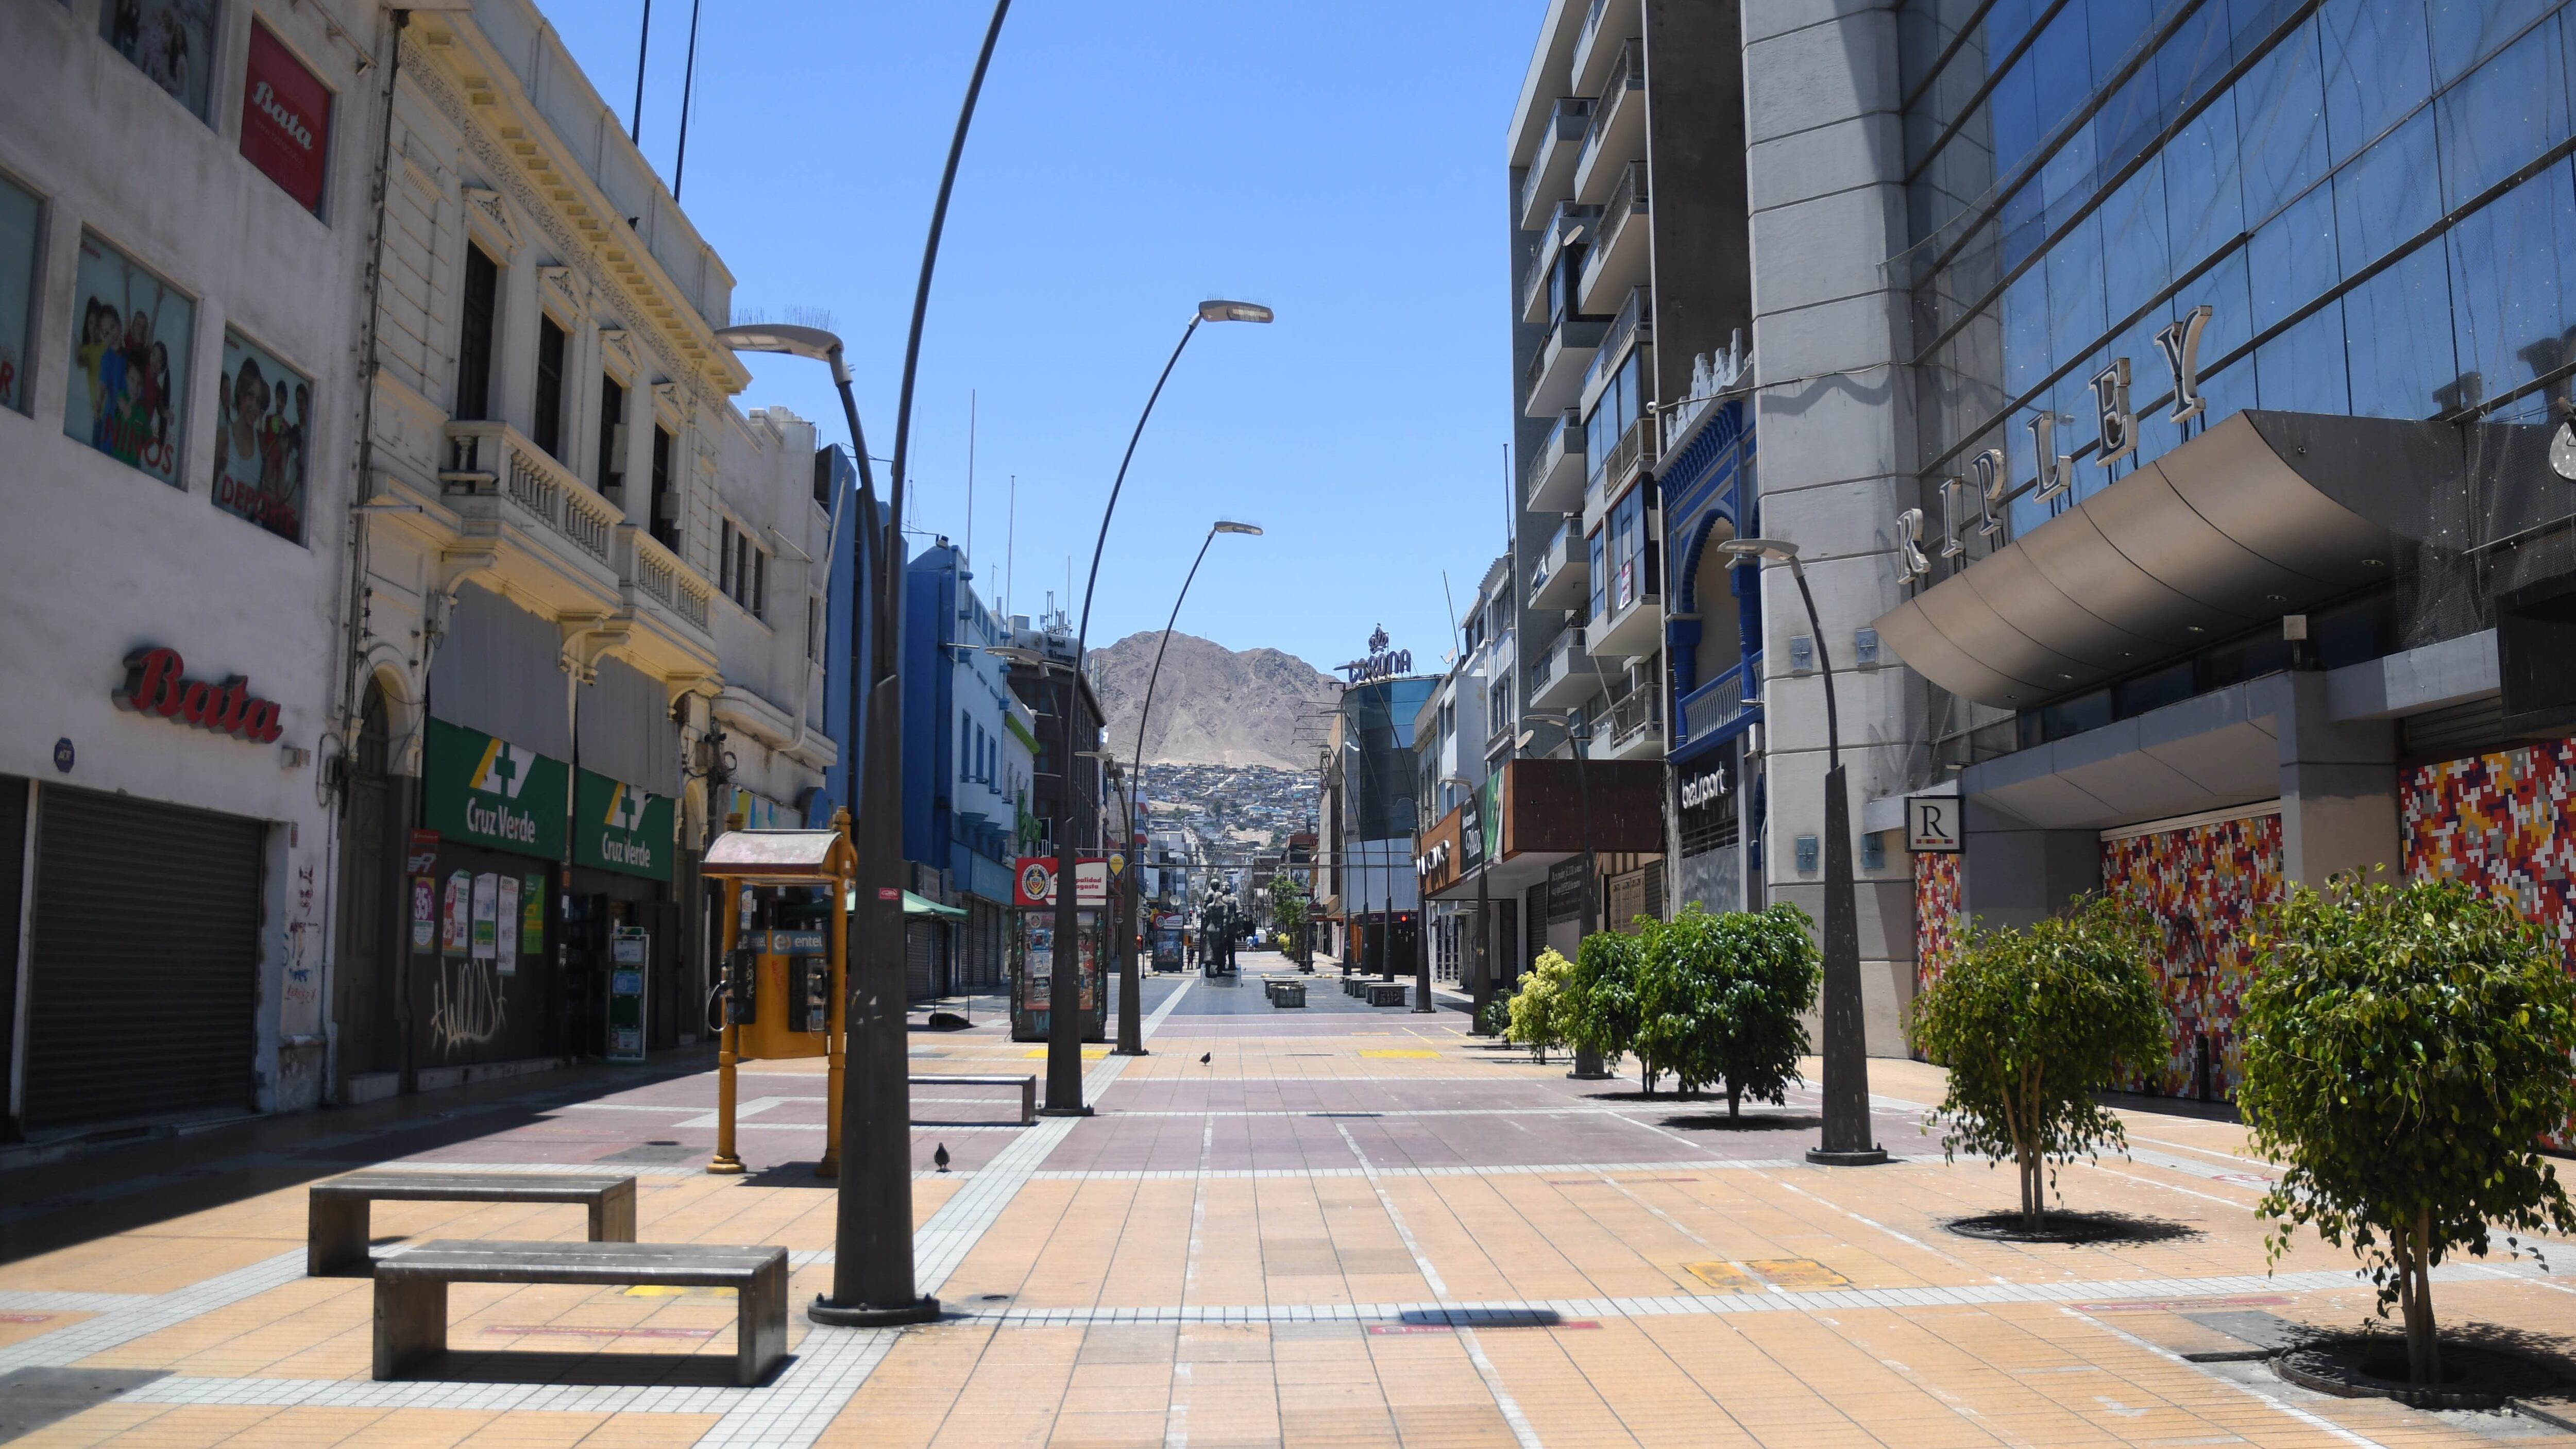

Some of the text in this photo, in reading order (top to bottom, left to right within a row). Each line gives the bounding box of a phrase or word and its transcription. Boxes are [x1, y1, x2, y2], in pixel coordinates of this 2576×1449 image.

[251, 81, 313, 151] Bata
[1896, 305, 2213, 585] RIPLEY
[1349, 649, 1411, 683] CORONA
[124, 646, 283, 743] Bata
[1682, 761, 1728, 810] belsport
[466, 797, 536, 843] Cruz Verde
[1920, 805, 1948, 837] R
[602, 832, 651, 868] Cruz Verde
[794, 936, 823, 948] entel
